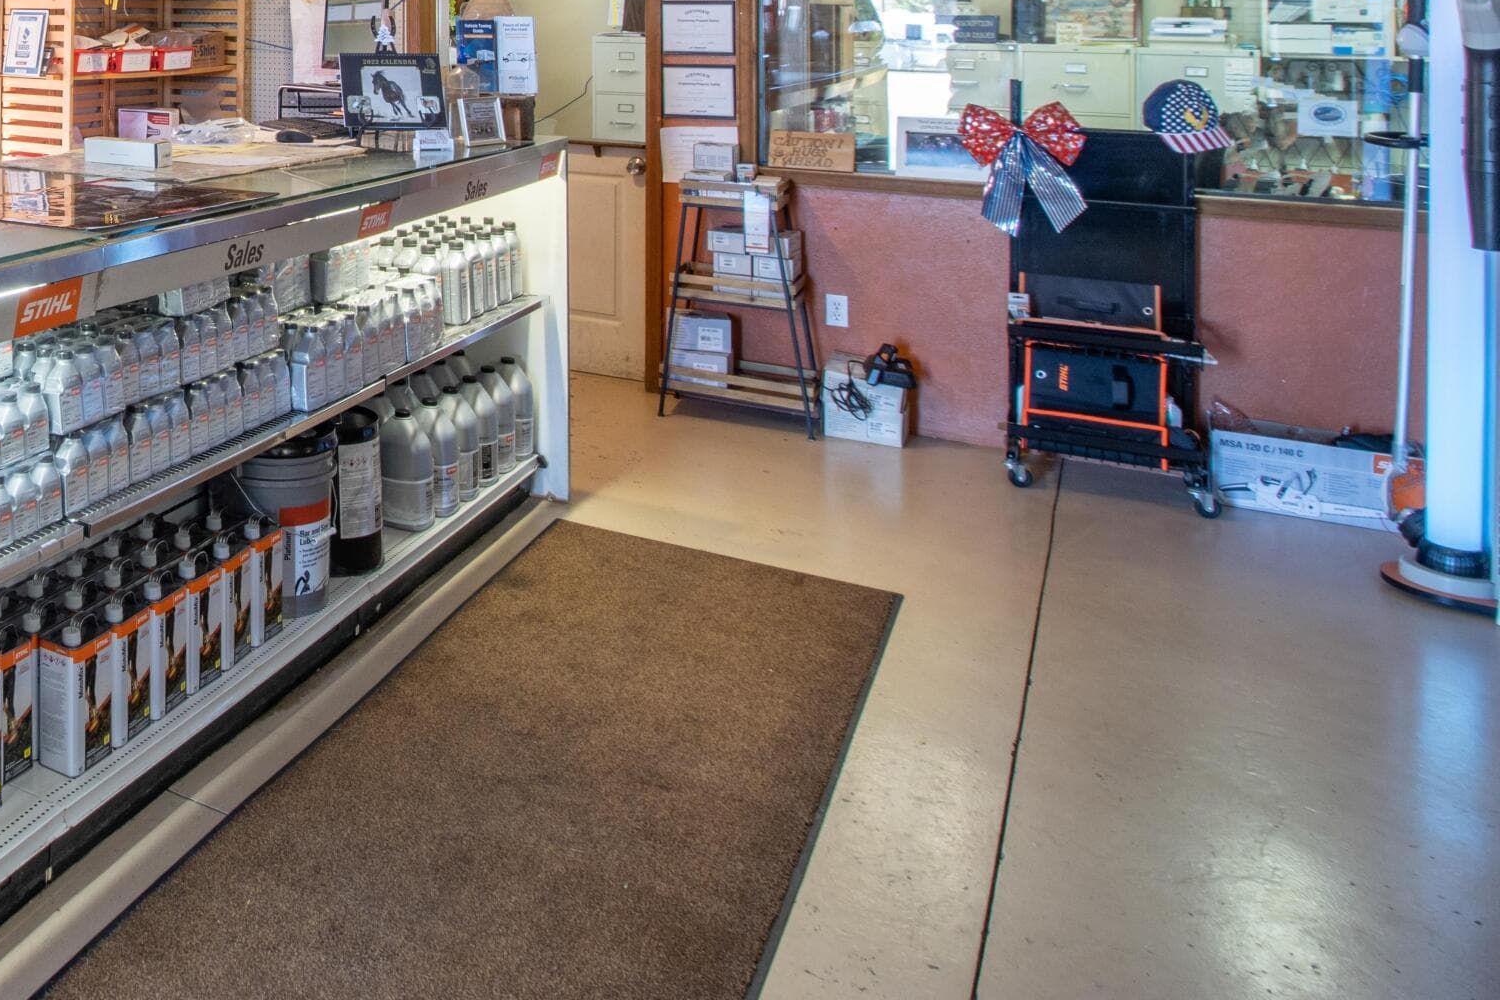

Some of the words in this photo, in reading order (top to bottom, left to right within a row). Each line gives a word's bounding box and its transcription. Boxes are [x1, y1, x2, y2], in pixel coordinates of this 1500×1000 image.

[465, 181, 489, 202] Sales
[361, 213, 389, 231] STIHL
[224, 243, 264, 272] Sales
[20, 291, 73, 326] STIHL
[1059, 363, 1069, 392] STIHL
[1219, 438, 1243, 449] MSA
[1246, 442, 1261, 452] 120
[1262, 444, 1270, 453] C
[15, 647, 29, 660] STIHL
